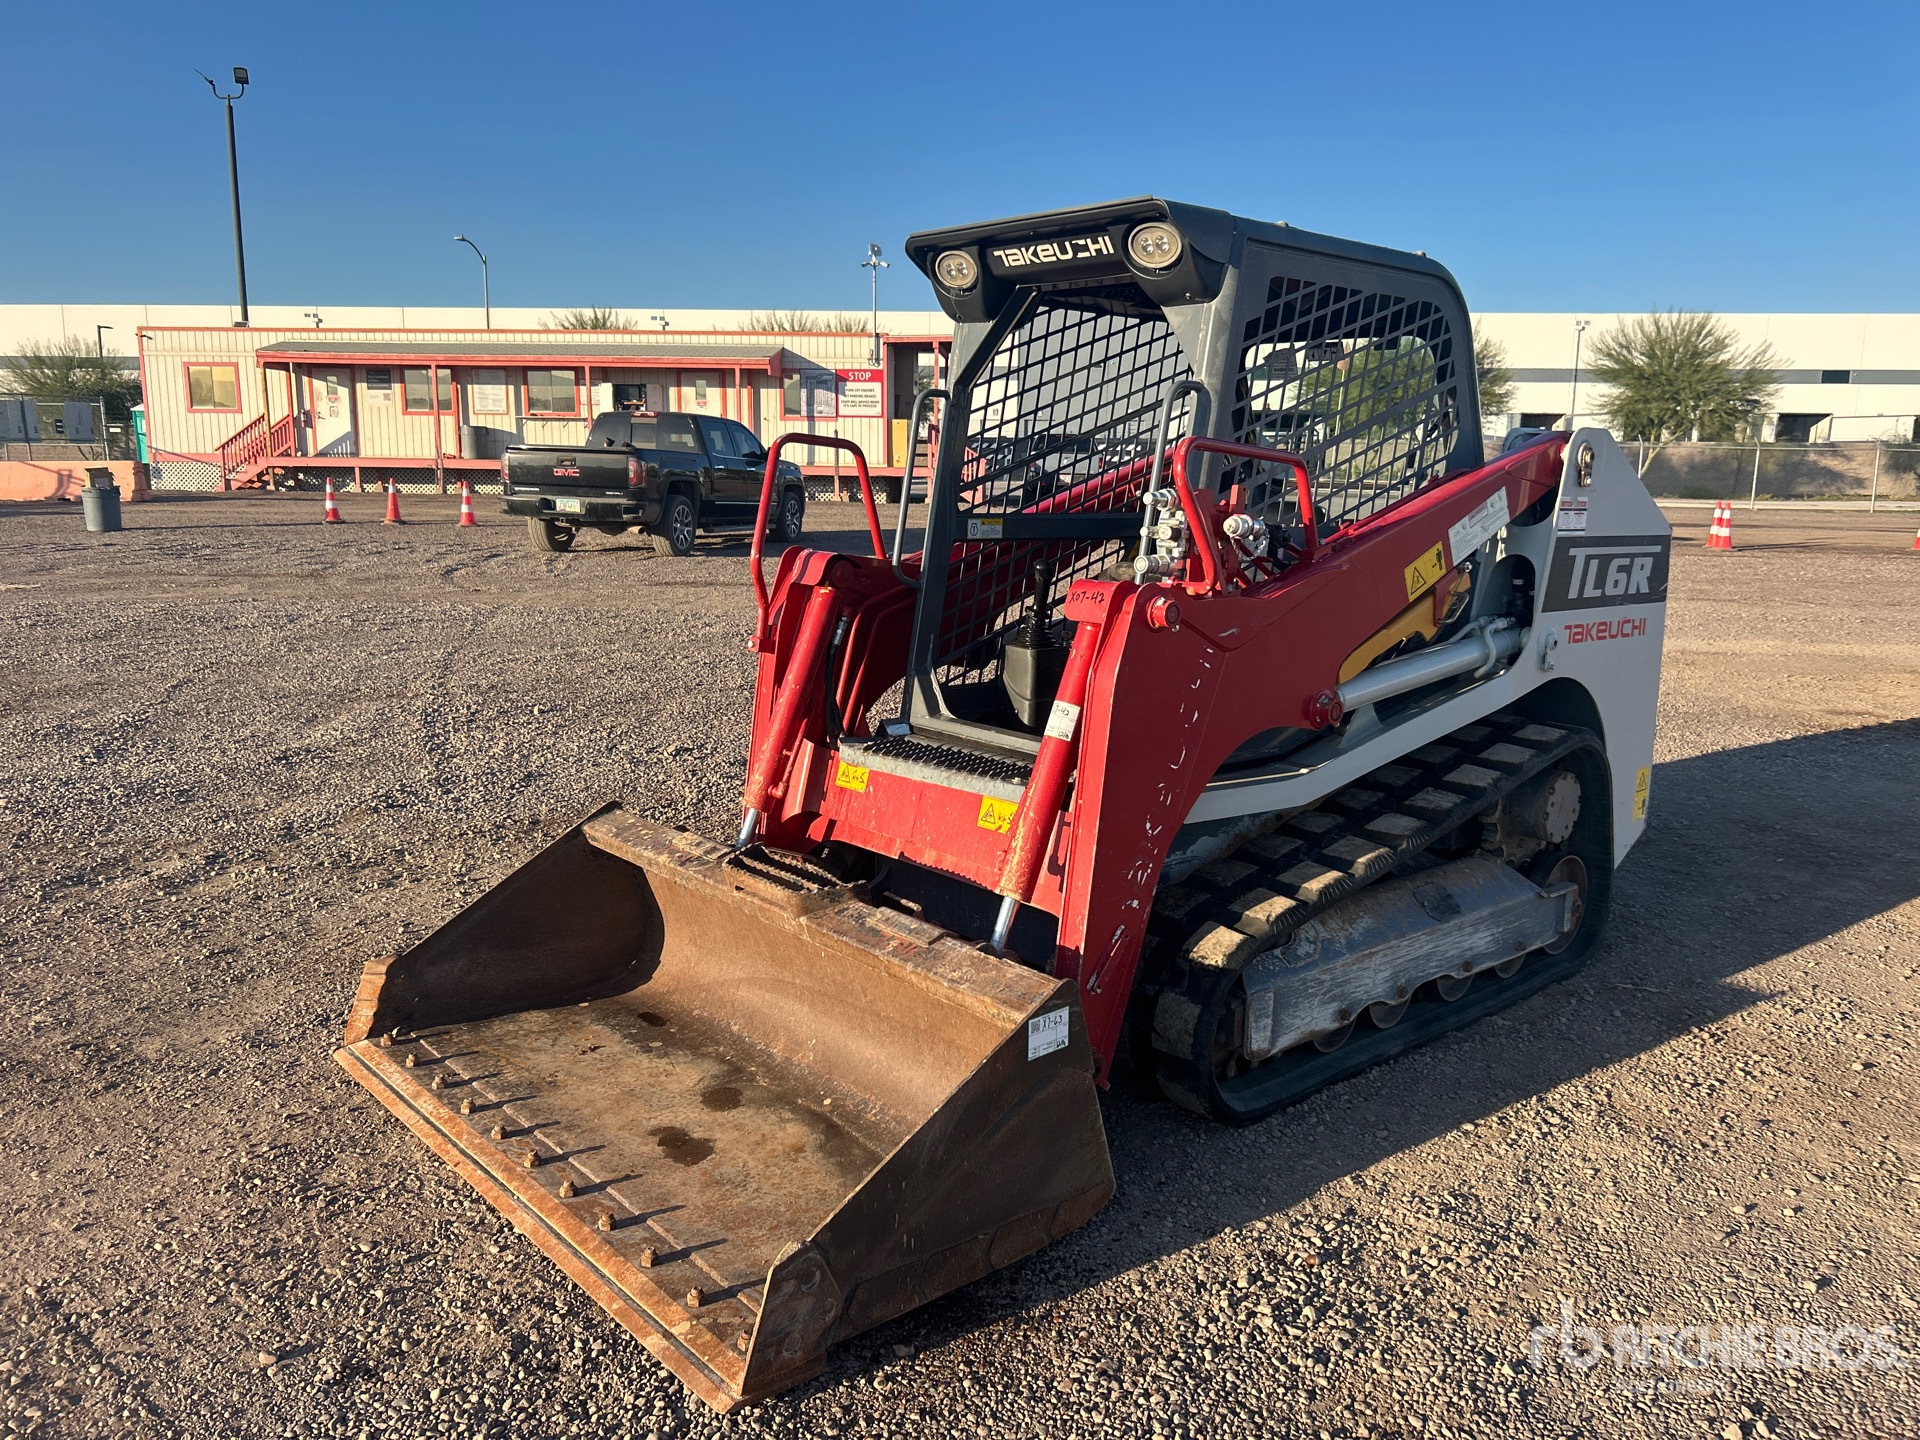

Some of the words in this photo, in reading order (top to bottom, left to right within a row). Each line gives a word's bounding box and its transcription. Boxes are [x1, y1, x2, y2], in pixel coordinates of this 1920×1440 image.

[992, 235, 1115, 268] TAKEUCHI
[848, 371, 872, 381] STOP
[553, 468, 580, 477] GMC
[1567, 545, 1662, 600] TL6R
[1068, 590, 1105, 605] X07-42
[1563, 617, 1647, 644] TAKEUCHI
